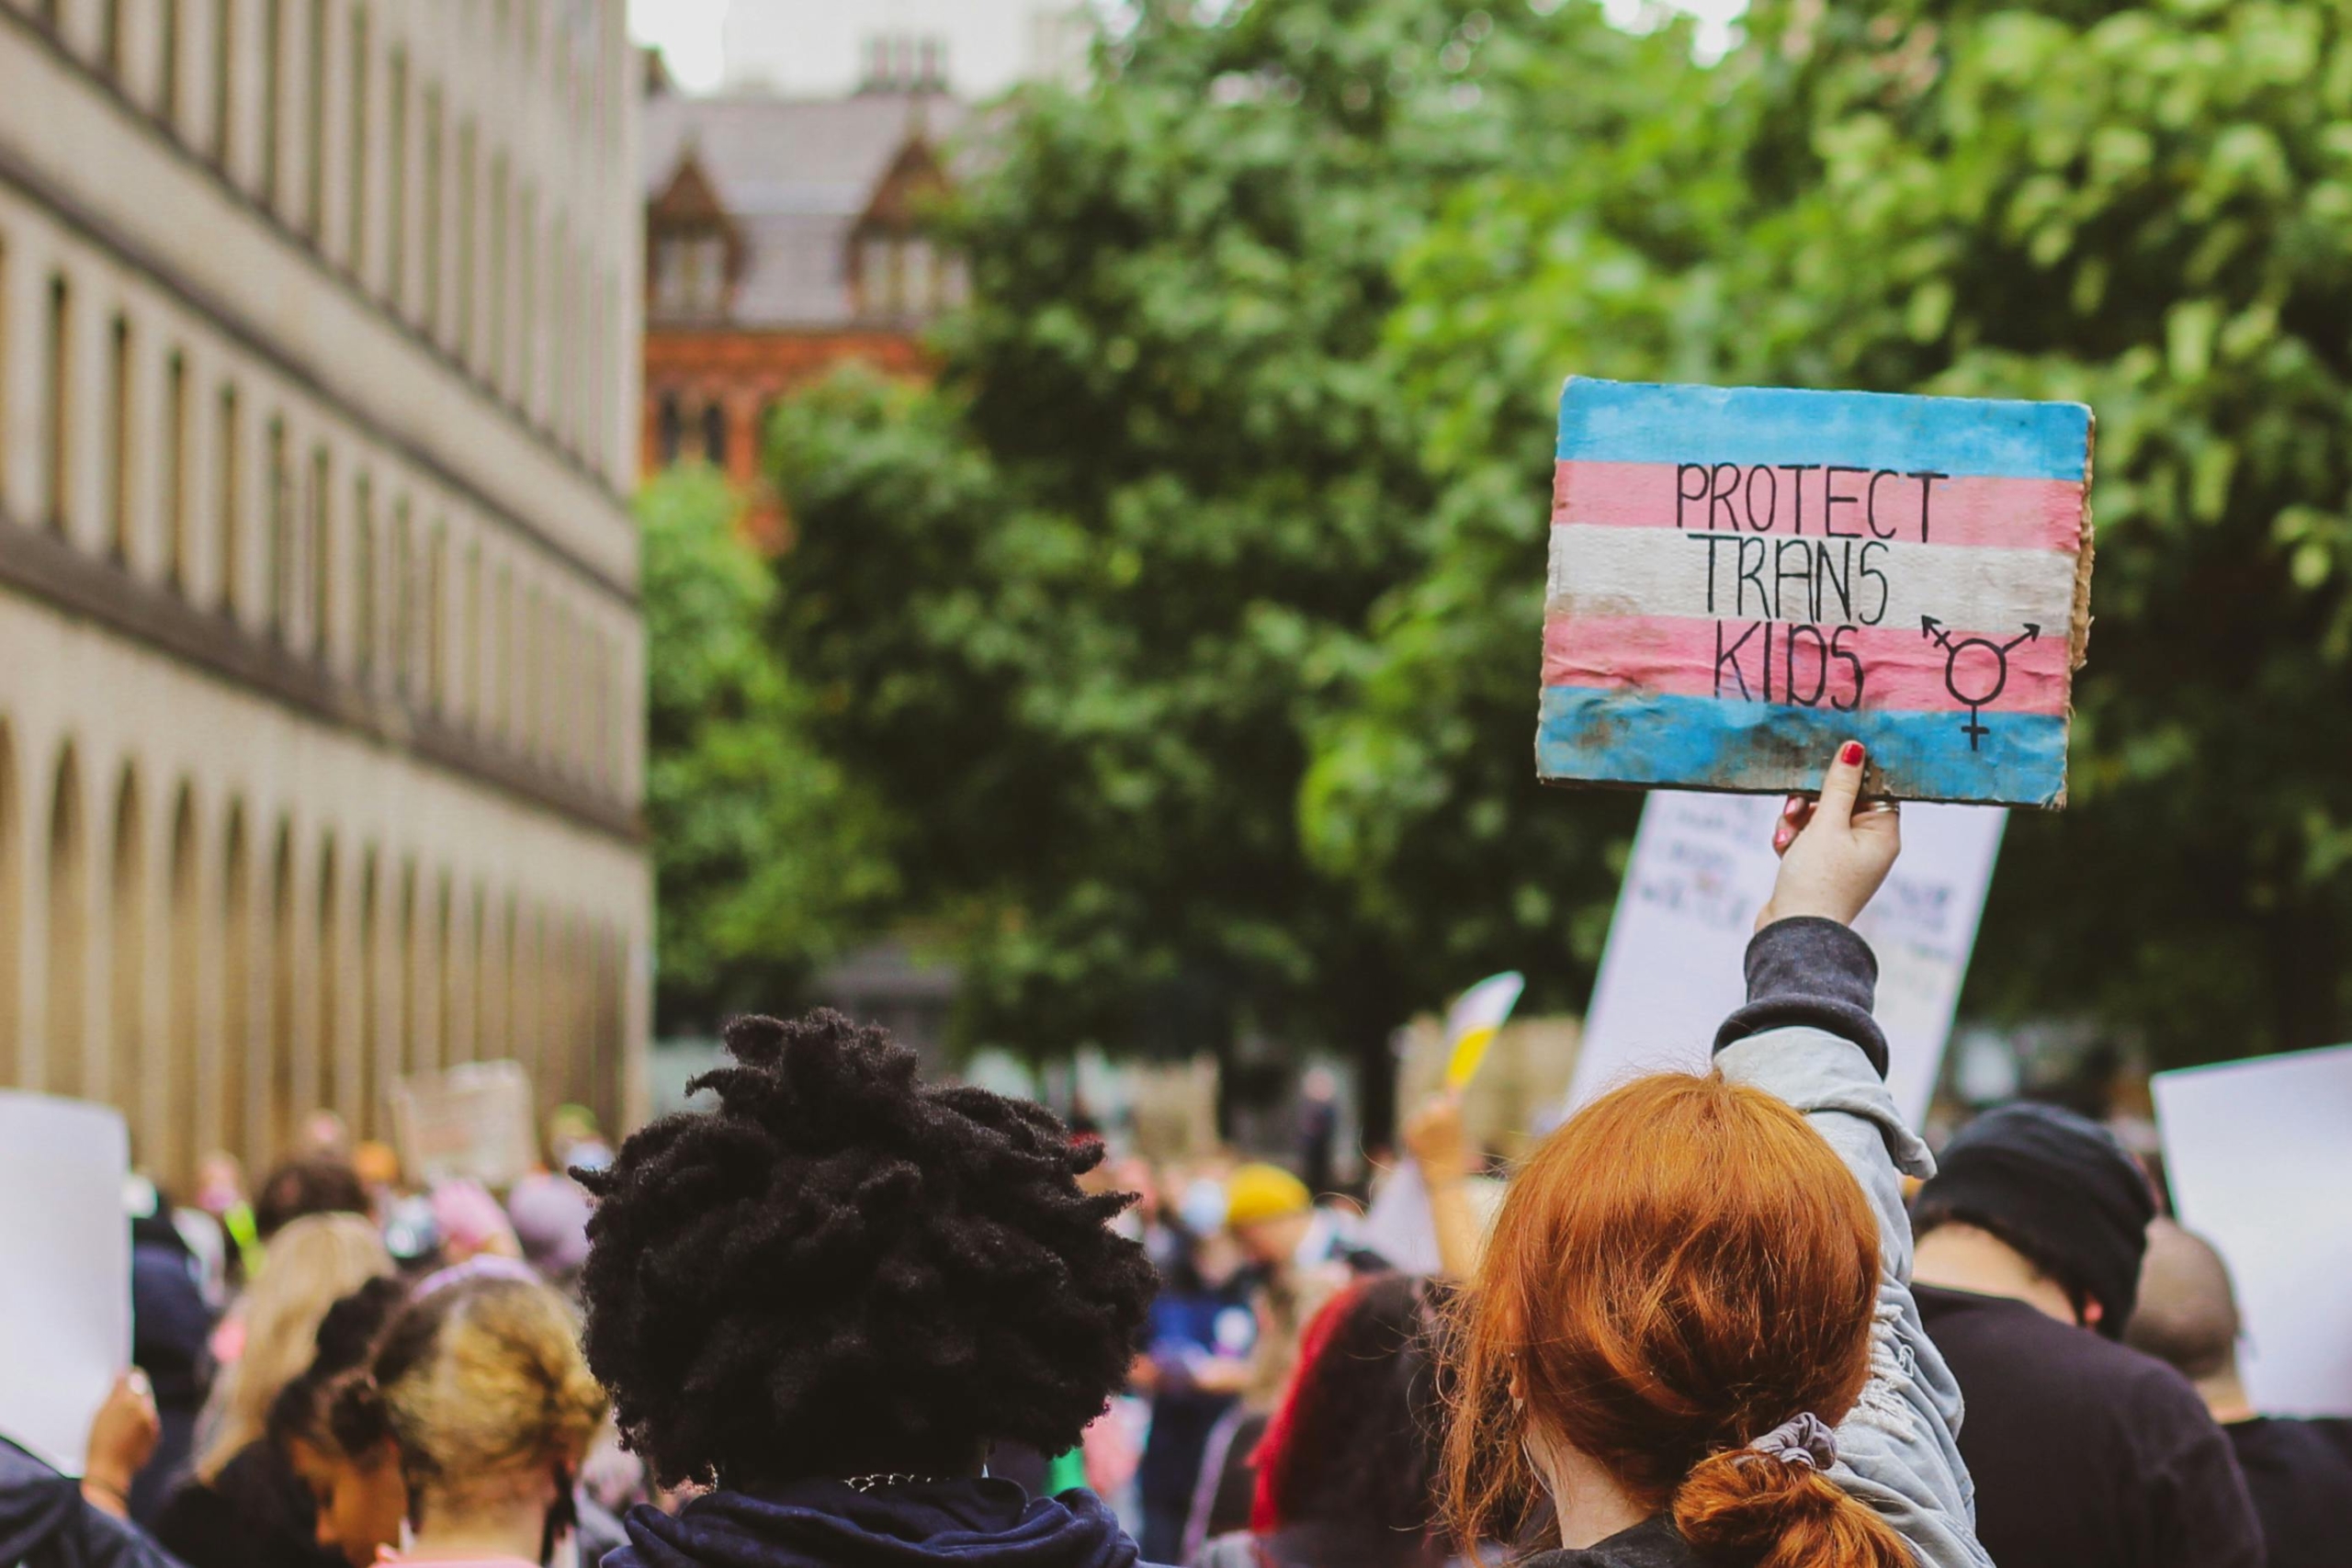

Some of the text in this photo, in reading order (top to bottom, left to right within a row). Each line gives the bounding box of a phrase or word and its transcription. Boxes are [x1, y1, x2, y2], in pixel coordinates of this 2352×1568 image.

[1677, 463, 1949, 543] PROTECT
[1688, 534, 1889, 626] TRANS
[1714, 620, 1864, 712] KIDS
